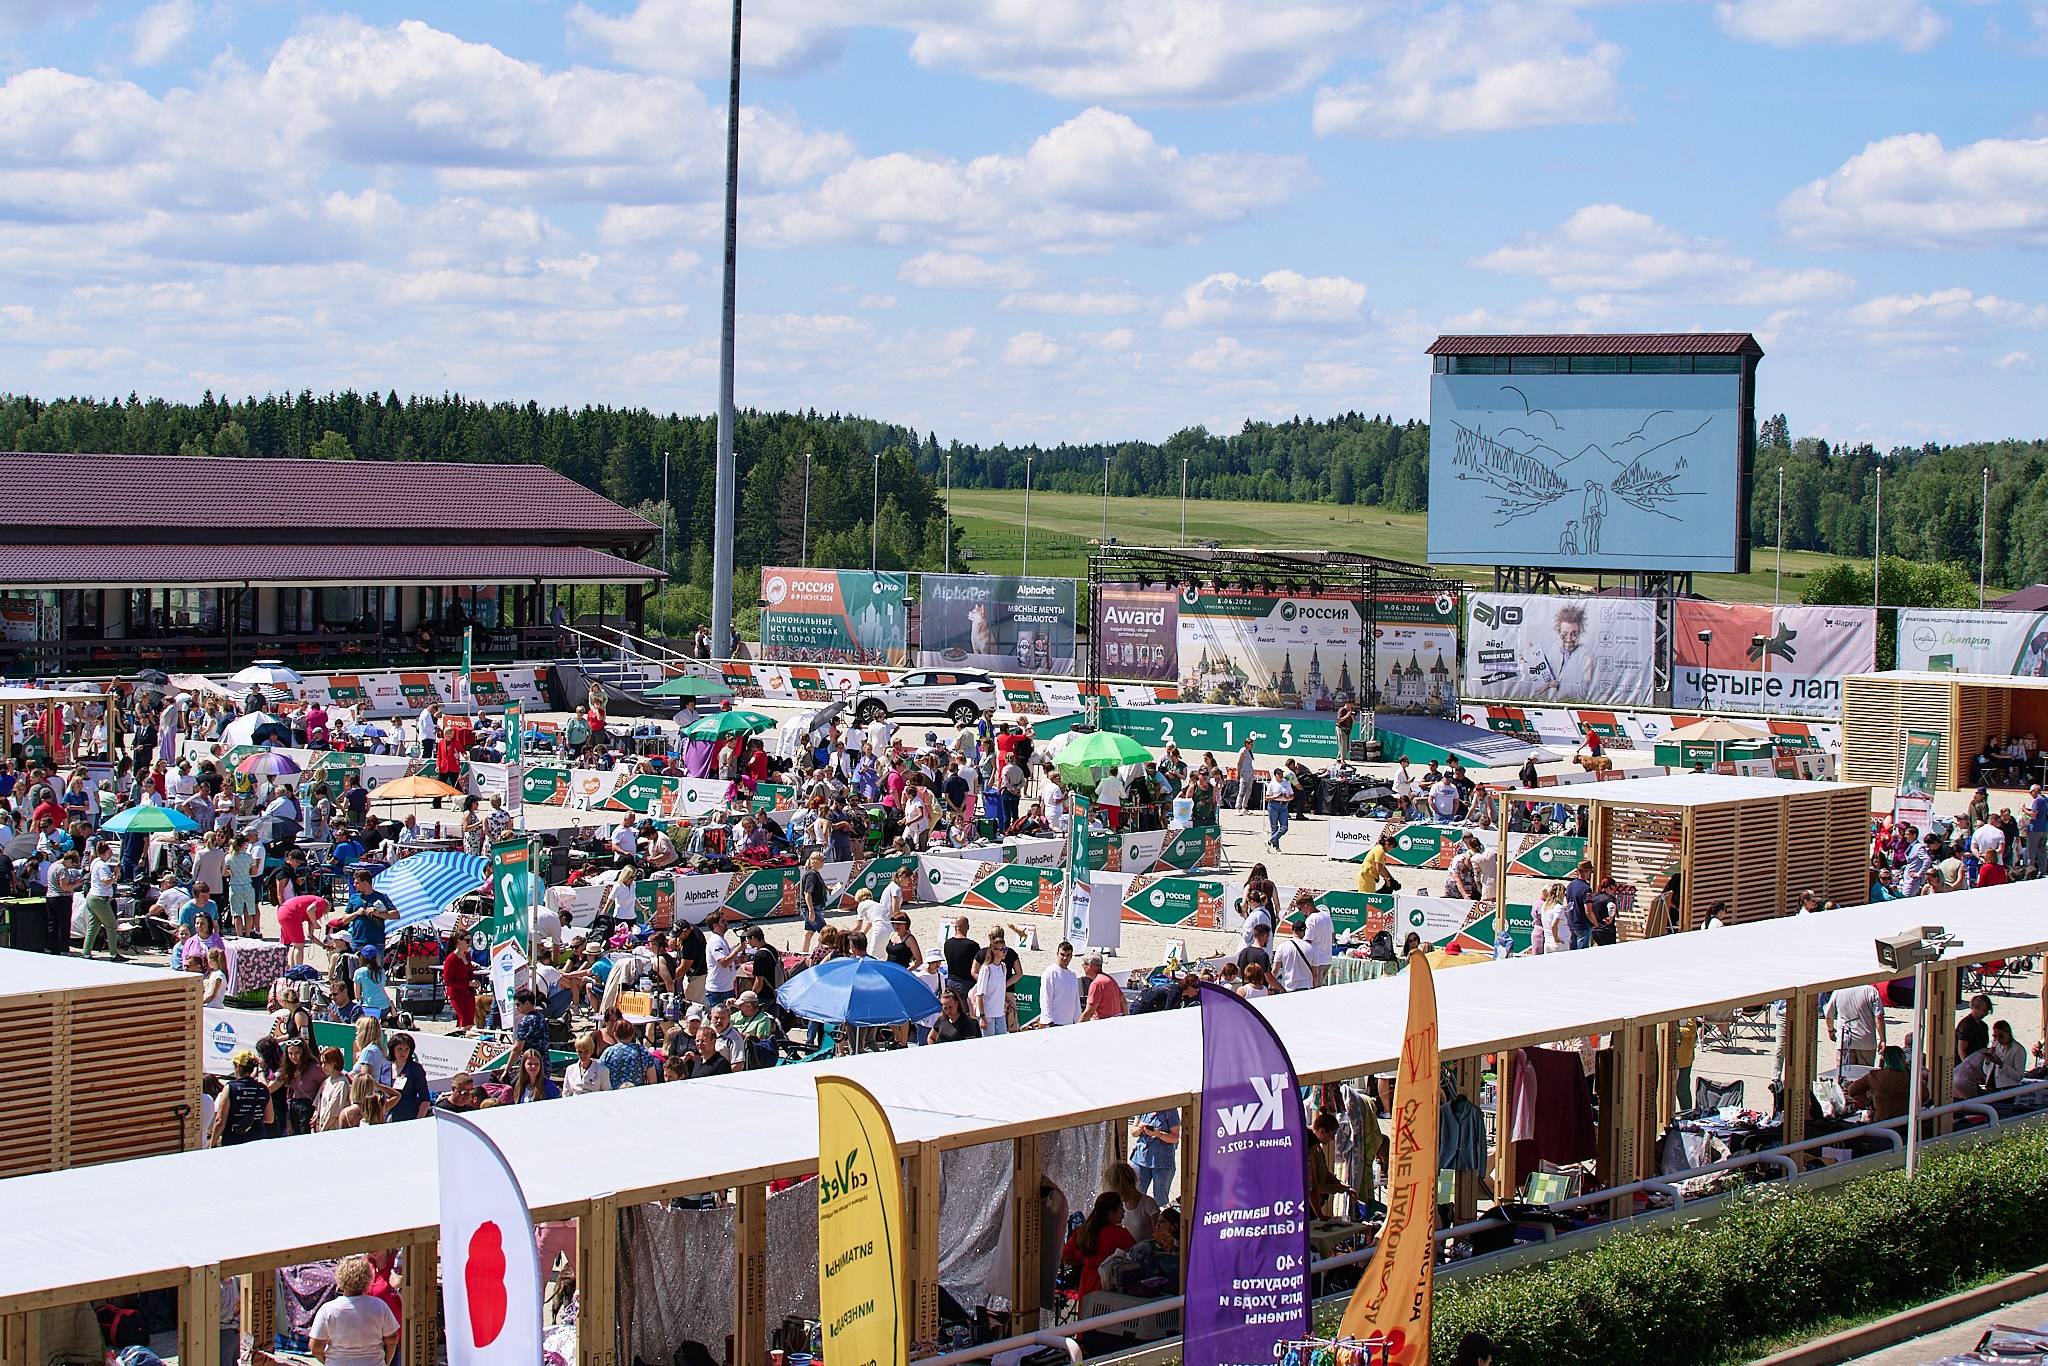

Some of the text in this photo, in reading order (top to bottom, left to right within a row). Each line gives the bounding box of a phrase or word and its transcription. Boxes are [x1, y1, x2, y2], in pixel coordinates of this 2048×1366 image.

[792, 582, 834, 593] РОССИЯ
[1017, 585, 1056, 596] AlphaPet
[1007, 605, 1037, 613] МЯСНЫЕ
[1299, 608, 1348, 619] РОССИЯ
[769, 616, 832, 626] АЦИОНАЛЬНЫЕ
[1014, 615, 1058, 623] СБЫВАЮТСЯ
[1104, 606, 1164, 626] Award
[1834, 619, 1862, 627] 4lapy.ru
[811, 627, 838, 635] СОБАК
[1941, 630, 1992, 647] Champion
[1686, 672, 1842, 699] четыре лап
[1160, 717, 1174, 741] 2
[1223, 721, 1233, 746] 1
[1278, 724, 1293, 749] 3
[1915, 751, 1929, 777] 4
[576, 798, 584, 810] 2
[651, 805, 656, 816] 3
[1336, 830, 1371, 842] AlphaPet
[1025, 854, 1054, 865] AlphaPet
[1009, 879, 1033, 887] РОССИЯ
[685, 889, 719, 902] AlphaPet
[944, 924, 951, 940] 1
[1019, 934, 1027, 948] 2
[212, 1030, 238, 1044] Farmina
[422, 1052, 448, 1062] Российская
[422, 1062, 458, 1072] инологическая
